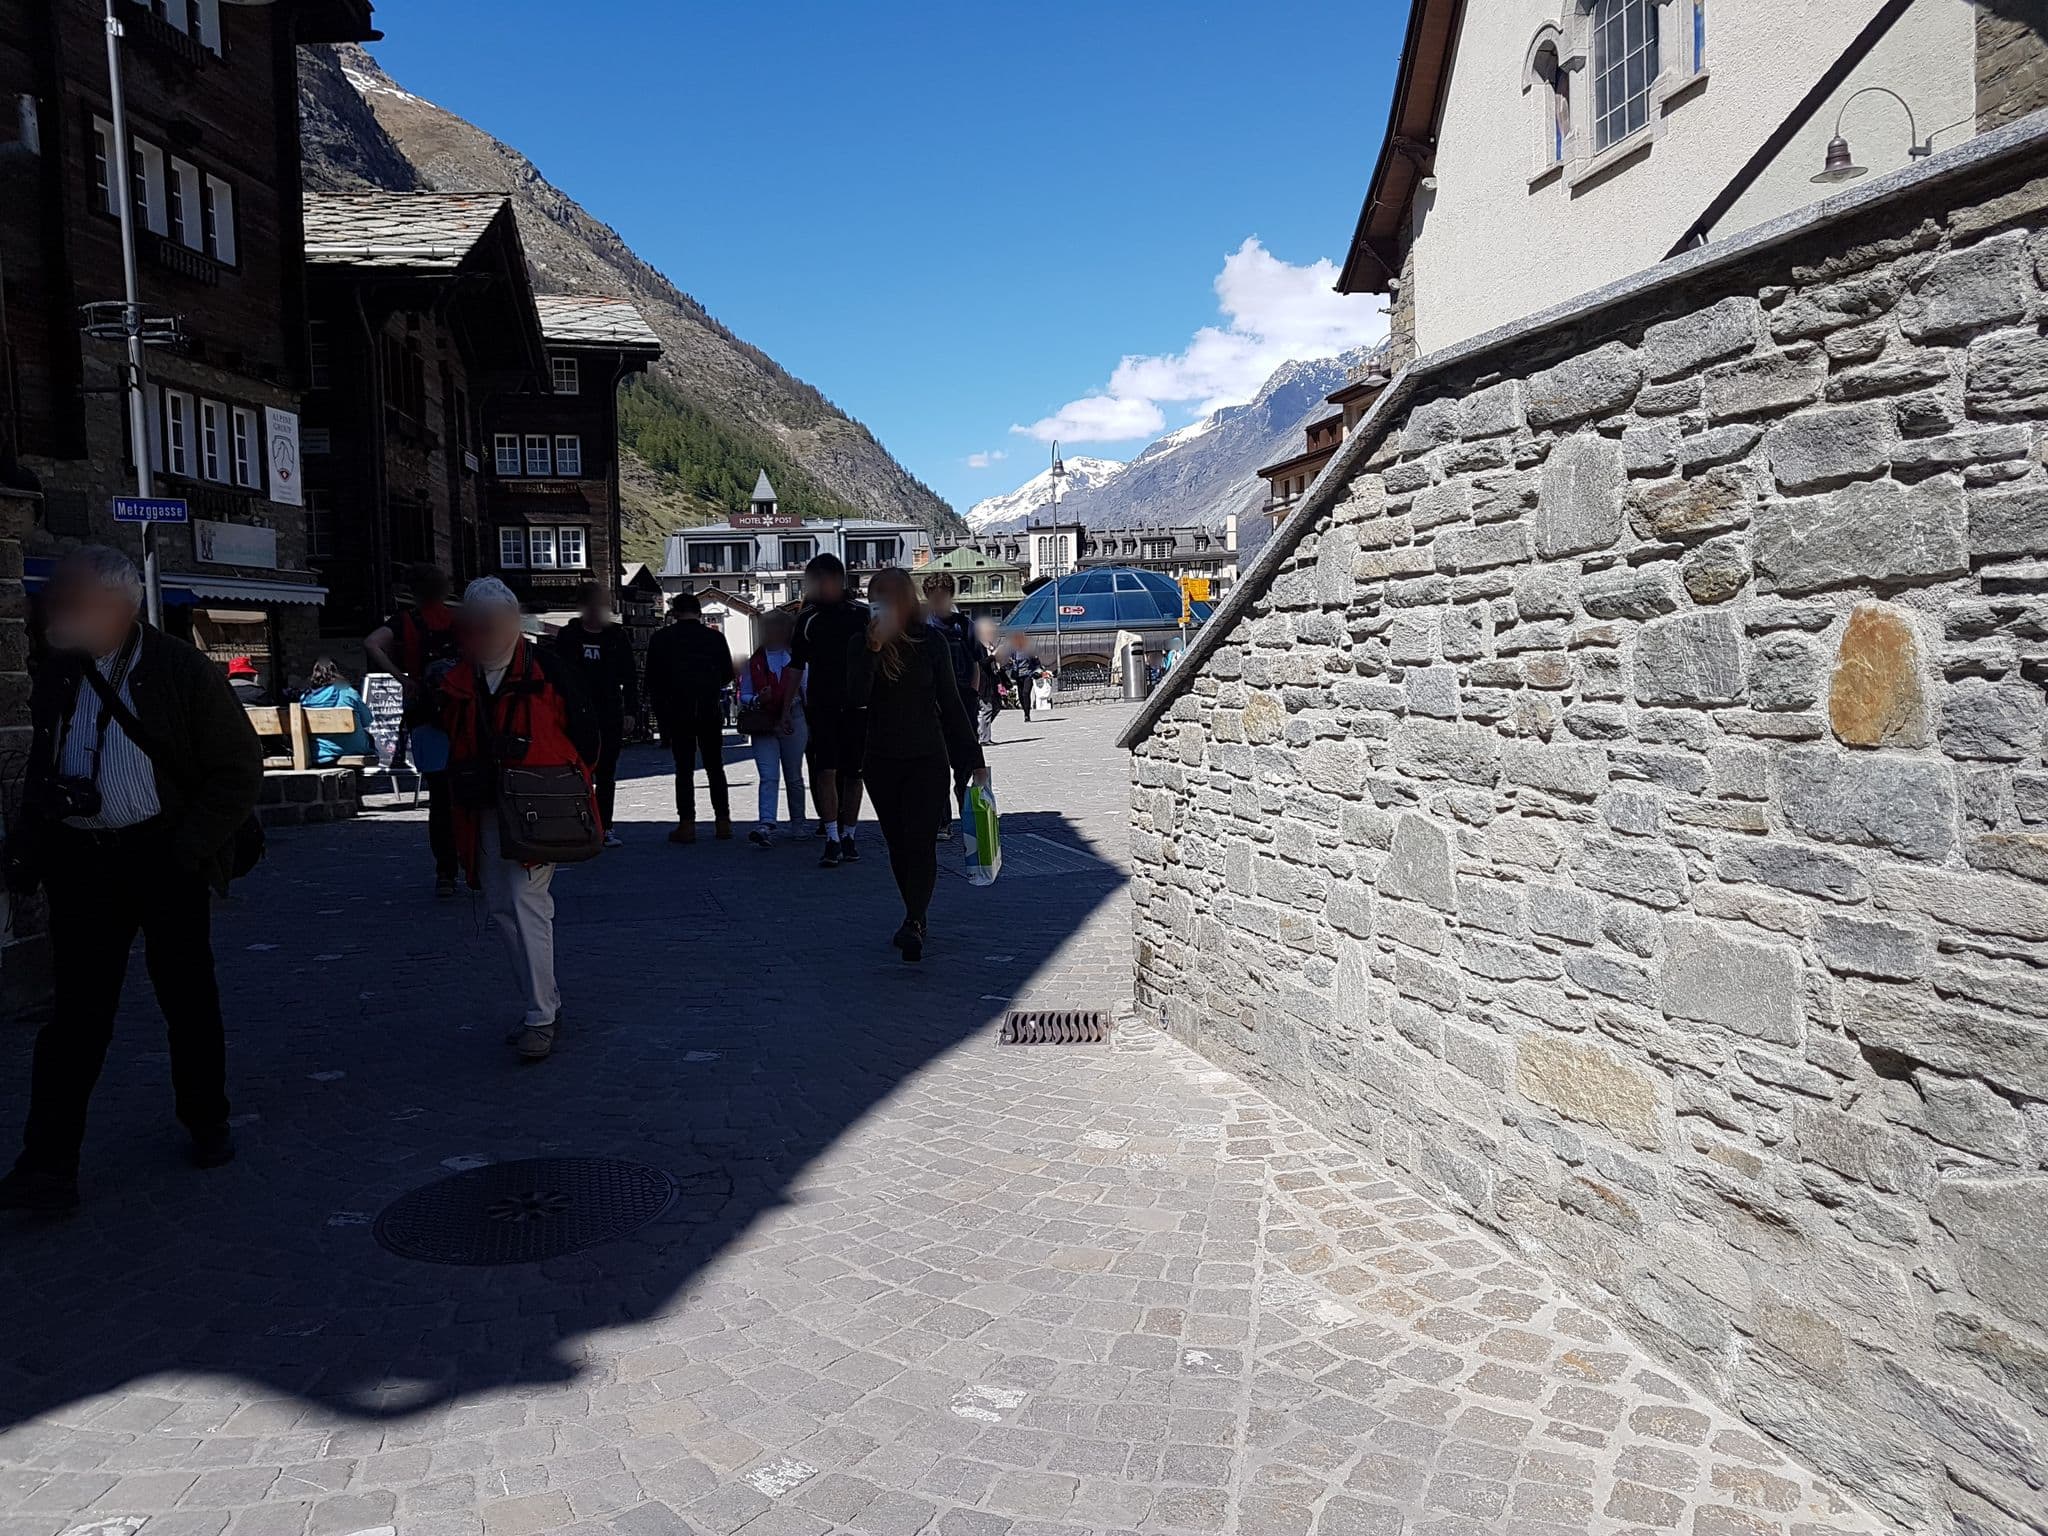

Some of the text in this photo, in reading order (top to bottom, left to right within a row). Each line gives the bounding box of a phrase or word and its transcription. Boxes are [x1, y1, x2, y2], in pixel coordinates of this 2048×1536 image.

[117, 502, 183, 520] Metzggasse
[739, 516, 792, 525] HOTEL POST
